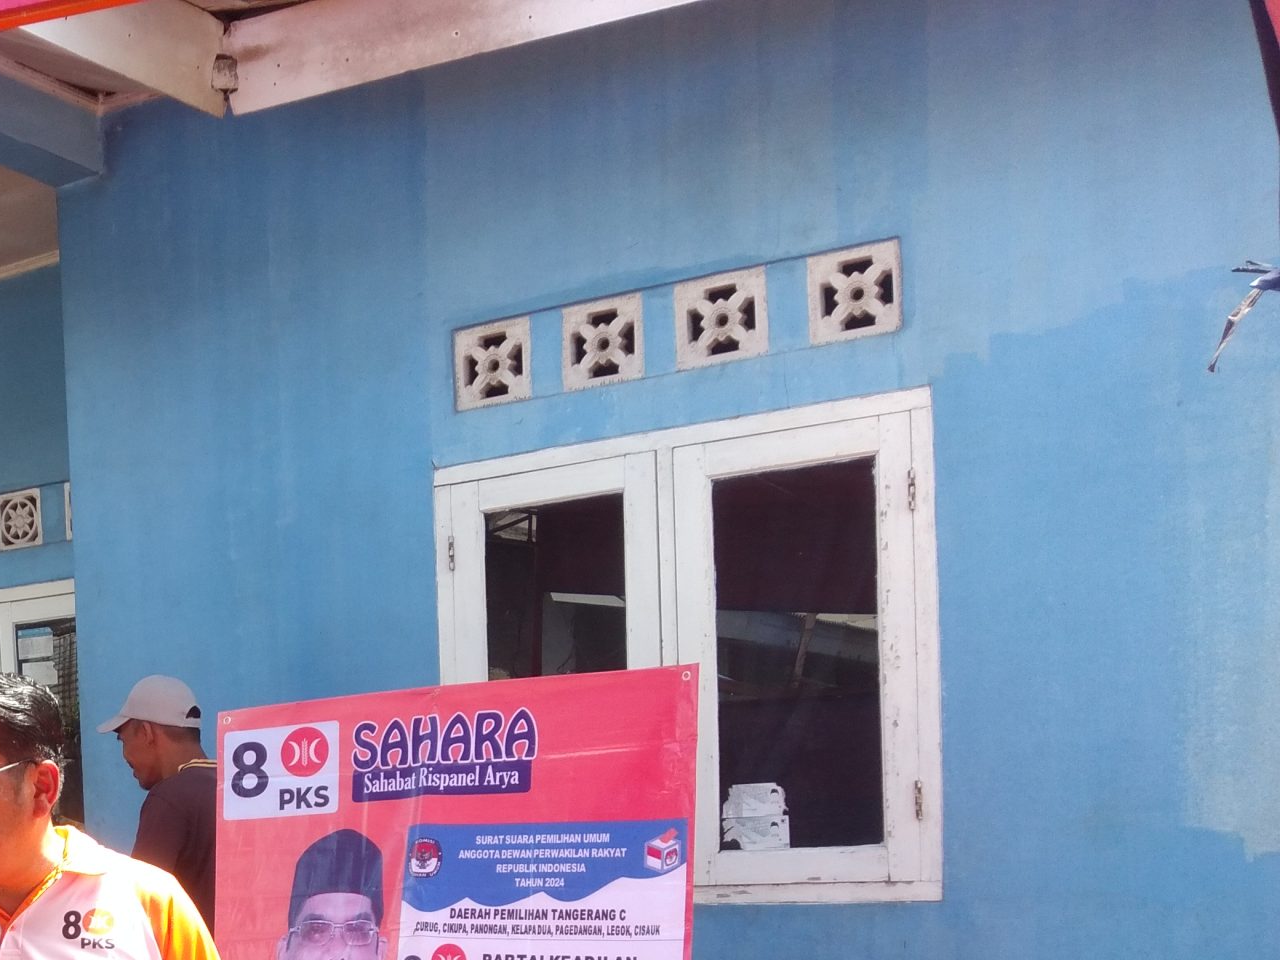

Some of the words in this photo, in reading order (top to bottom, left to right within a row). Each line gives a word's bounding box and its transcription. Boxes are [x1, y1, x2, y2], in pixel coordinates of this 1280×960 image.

[352, 707, 537, 772] SAHARA
[231, 742, 269, 798] 8
[363, 773, 417, 794] Sahabat
[419, 766, 480, 791] Rispanel
[484, 765, 519, 788] Arya
[279, 785, 330, 811] PKS
[476, 835, 504, 845] SURAT
[505, 834, 534, 844] SUARA
[535, 833, 581, 844] PEMILIHAN
[583, 833, 610, 843] UMUM
[458, 849, 500, 859] ANGGOTA
[501, 849, 532, 858] DEWAN
[533, 848, 589, 858] PERWAKILAN
[591, 848, 627, 858] RAKYAT
[496, 864, 537, 873] REPUBLIK
[539, 863, 586, 872] INDONESIA
[515, 878, 543, 887] TAHUN
[545, 878, 565, 887] 2024
[450, 908, 491, 919] DAERAH
[493, 908, 548, 920] PEMILIHAN
[551, 909, 616, 920] TANGERANG
[619, 909, 626, 920] C
[62, 910, 81, 940] 8
[415, 921, 440, 934] CURUG,
[442, 923, 469, 935] CIKUPA,
[470, 923, 509, 936] PANONGAN,
[511, 924, 536, 935] KELAPA
[537, 925, 554, 937] DUA,
[555, 925, 605, 938] PAGEDANGAN,
[607, 925, 632, 938] LEGOK,
[634, 925, 660, 936] CISAUK
[81, 937, 115, 949] PKS
